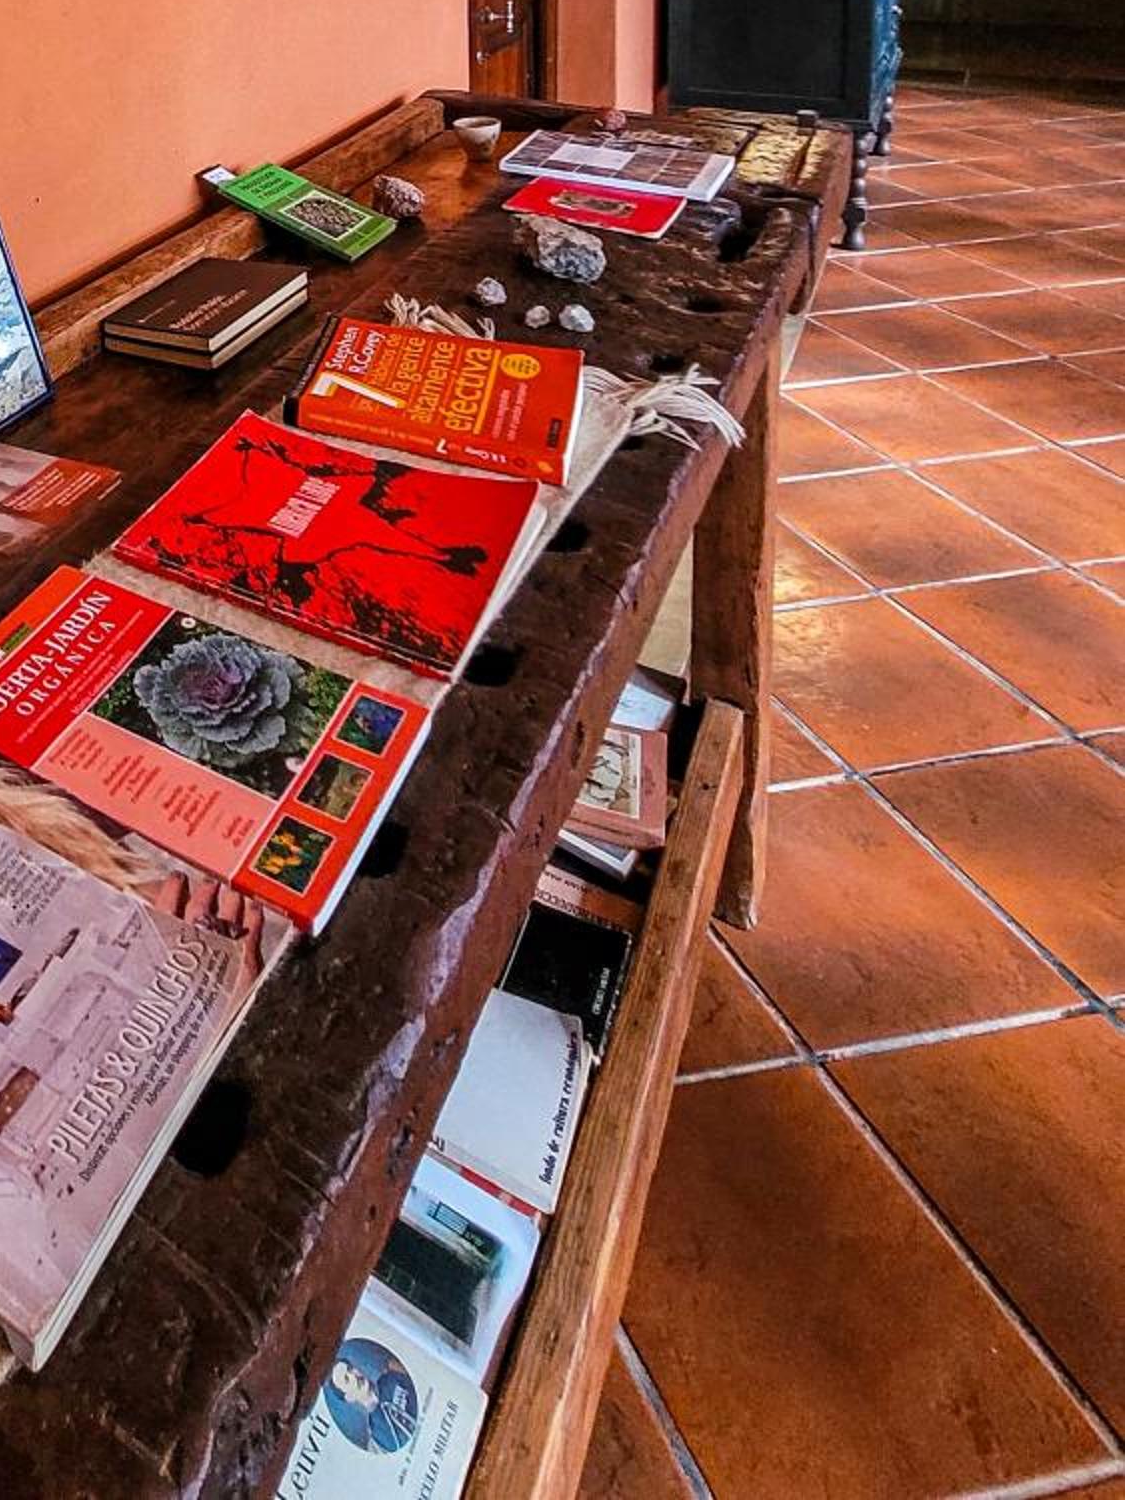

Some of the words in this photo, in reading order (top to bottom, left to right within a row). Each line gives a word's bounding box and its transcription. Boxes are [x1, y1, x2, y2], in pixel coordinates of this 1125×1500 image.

[324, 326, 359, 369] Stephen
[395, 336, 426, 381] gente
[407, 340, 457, 423] altamente
[438, 345, 492, 432] efectiva
[311, 368, 408, 412] 7
[15, 618, 116, 716] ORGÁNICA
[116, 931, 208, 1054] QUINCHOS
[102, 1044, 140, 1077] &
[46, 1065, 128, 1163] PILETAS
